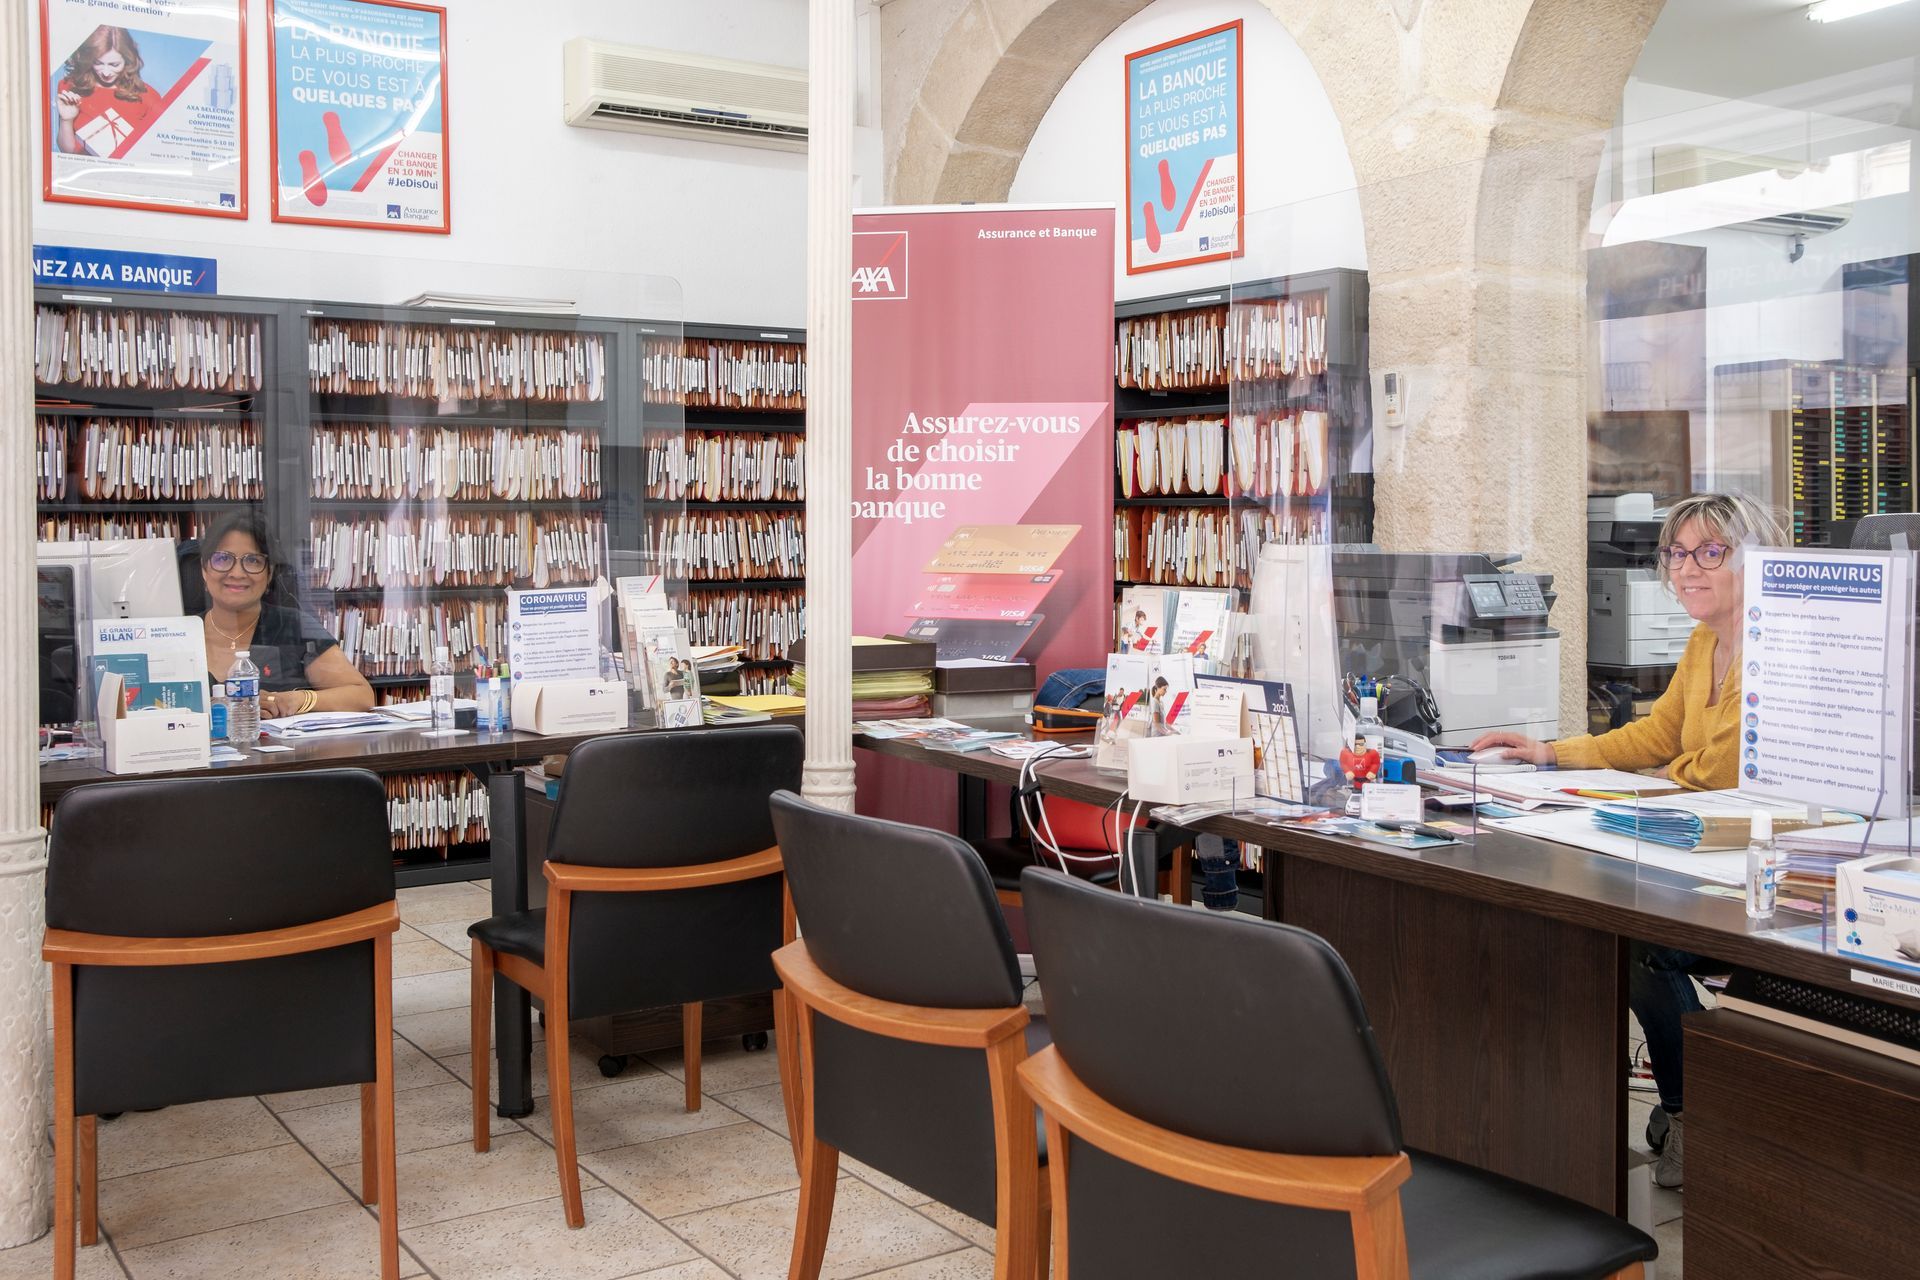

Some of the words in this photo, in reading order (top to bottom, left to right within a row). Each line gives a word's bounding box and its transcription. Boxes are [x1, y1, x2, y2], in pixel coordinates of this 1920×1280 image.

[88, 0, 119, 9] grande
[122, 4, 163, 16] attention
[291, 44, 310, 60] LA
[316, 47, 357, 65] PLUS
[362, 54, 425, 74] PROCHE
[292, 65, 316, 84] DE
[322, 69, 371, 89] VOUS
[377, 75, 409, 93] EST
[415, 77, 426, 94] À
[1140, 79, 1157, 101] LA
[1162, 57, 1227, 94] BANQUE
[292, 87, 387, 109] QUELQUES
[1140, 104, 1151, 119] LA
[1154, 95, 1181, 115] PLUS
[1183, 82, 1227, 106] PROCHE
[188, 120, 231, 129] CONVICTIONS
[1140, 122, 1155, 140] DE
[1157, 113, 1189, 134] VOUS
[1193, 105, 1216, 126] EST
[1219, 100, 1228, 119] À
[1140, 130, 1200, 158] QUELQUES
[1203, 124, 1227, 142] PAS
[398, 151, 438, 160] CHANGER
[393, 159, 404, 167] DE
[406, 159, 438, 169] BANQUE
[388, 167, 400, 175] EN
[402, 168, 413, 176] 10
[388, 177, 439, 190] #JeDisOui
[1206, 175, 1235, 188] CHANGER
[1203, 189, 1211, 197] DE
[1212, 185, 1235, 196] BANQUE
[1199, 199, 1208, 207] EN
[1209, 198, 1217, 206] 10
[403, 206, 439, 215] Assurance
[1199, 203, 1236, 219] #JeDisOui
[977, 227, 1036, 240] Assurance
[1038, 227, 1051, 238] et
[1053, 227, 1097, 239] Banque
[71, 262, 115, 281] AXA
[121, 265, 193, 287] BANQUE
[851, 266, 895, 293] AXA
[901, 411, 1081, 435] Assurez-vous
[887, 438, 920, 463] de
[926, 438, 1020, 463] choisir
[865, 466, 890, 491] la
[896, 466, 982, 491] bonne
[1764, 563, 1881, 582] CORONAVIRUS
[1763, 581, 1778, 589] Pour
[1785, 582, 1812, 591] protéger
[1820, 585, 1848, 594] protéger
[1849, 585, 1859, 593] les
[520, 593, 586, 605] CORONAVIRUS
[1000, 610, 1026, 618] VISA
[100, 632, 134, 642] BILAN
[1272, 703, 1290, 714] 2021
[1872, 976, 1894, 988] MARIE
